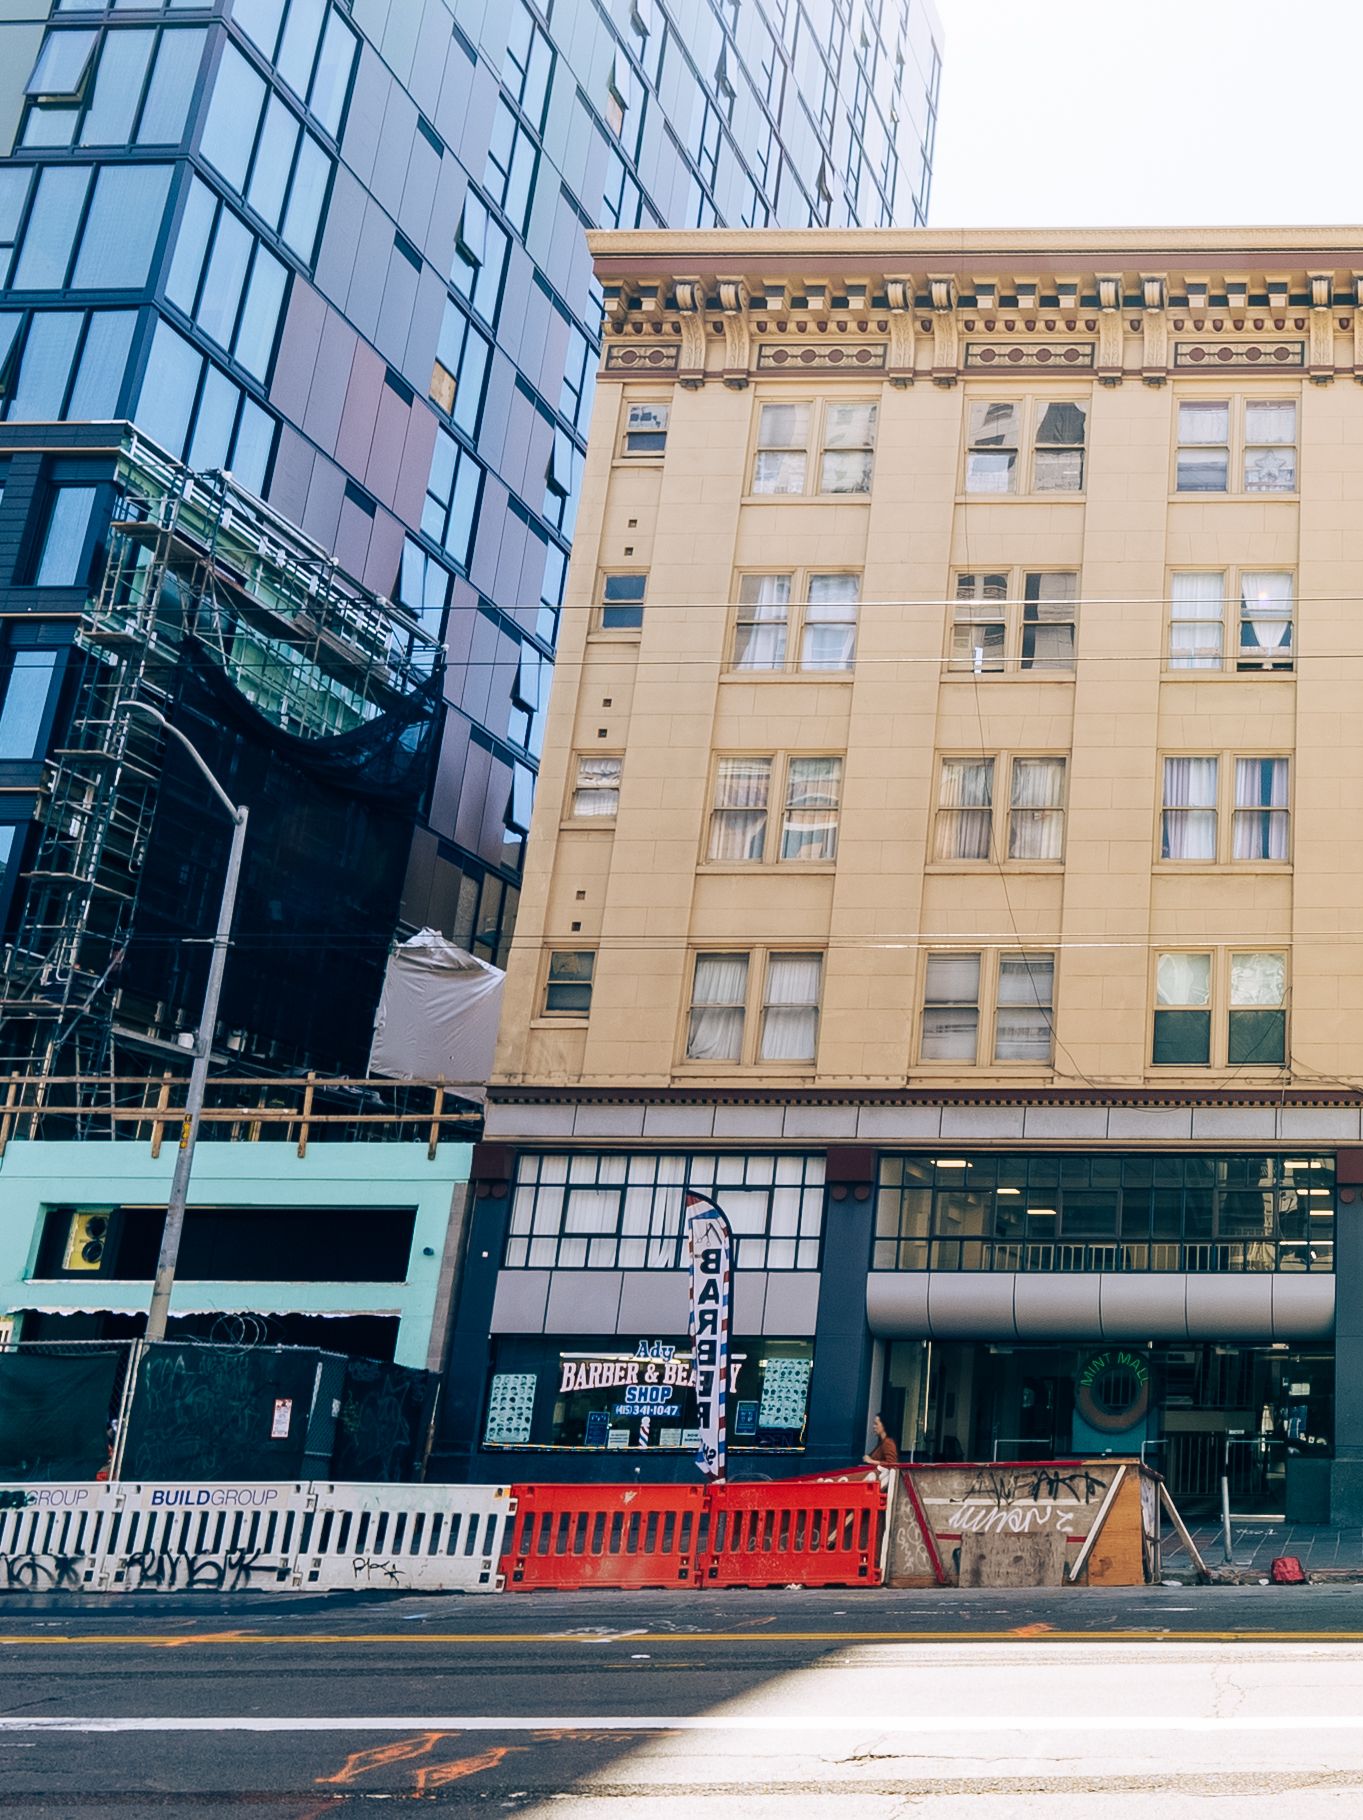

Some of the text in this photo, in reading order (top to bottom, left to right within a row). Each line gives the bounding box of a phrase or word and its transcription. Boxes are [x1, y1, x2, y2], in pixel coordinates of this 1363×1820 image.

[636, 1340, 675, 1362] Ady
[560, 1362, 639, 1393] BARBER
[645, 1364, 660, 1384] &
[1080, 1352, 1149, 1387] MINT MALL
[625, 1385, 673, 1404] SHOP
[151, 1489, 279, 1506] BUILDGROUP
